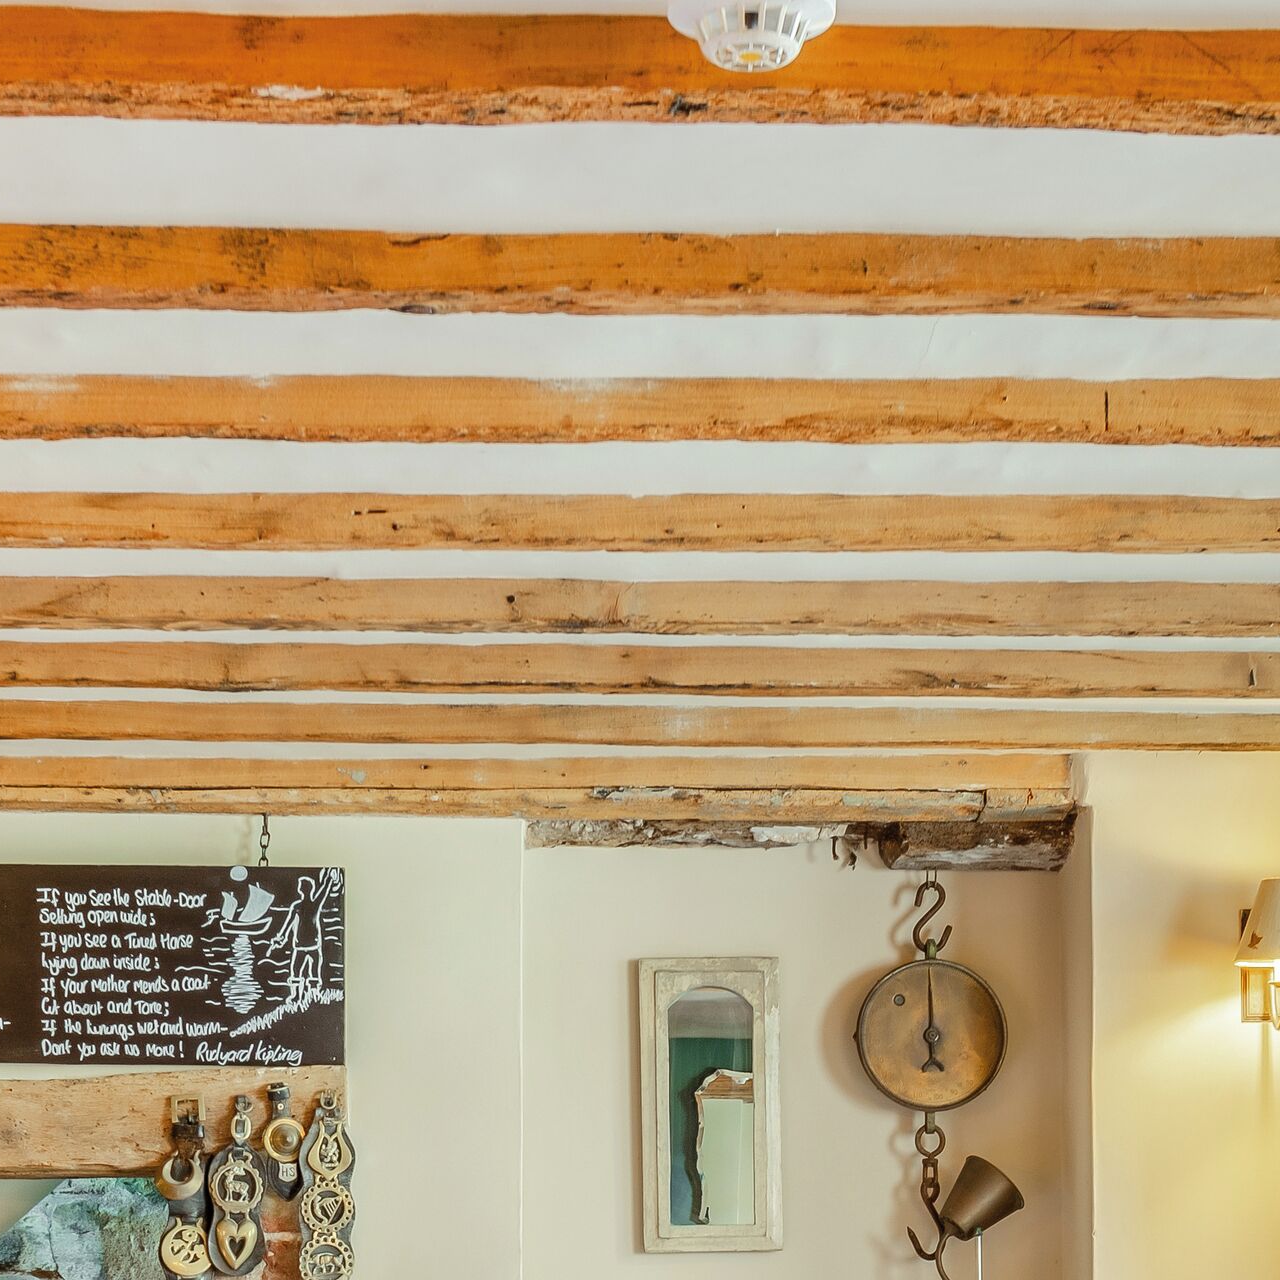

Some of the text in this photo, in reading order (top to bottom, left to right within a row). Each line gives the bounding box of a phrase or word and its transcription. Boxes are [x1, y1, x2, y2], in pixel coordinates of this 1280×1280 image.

[36, 888, 130, 911] If you the
[40, 932, 58, 952] If
[59, 935, 82, 953] you
[111, 935, 120, 948] a
[160, 933, 193, 949] Horse
[81, 953, 110, 971] down
[41, 977, 180, 997] If a
[64, 1000, 103, 1015] about
[107, 999, 132, 1015] and
[41, 1019, 57, 1037] If
[64, 1020, 82, 1035] the
[160, 1016, 183, 1035] and
[77, 1042, 120, 1062] you ask
[196, 1040, 303, 1066] Rudyard Kipling
[282, 1165, 295, 1176] HS
